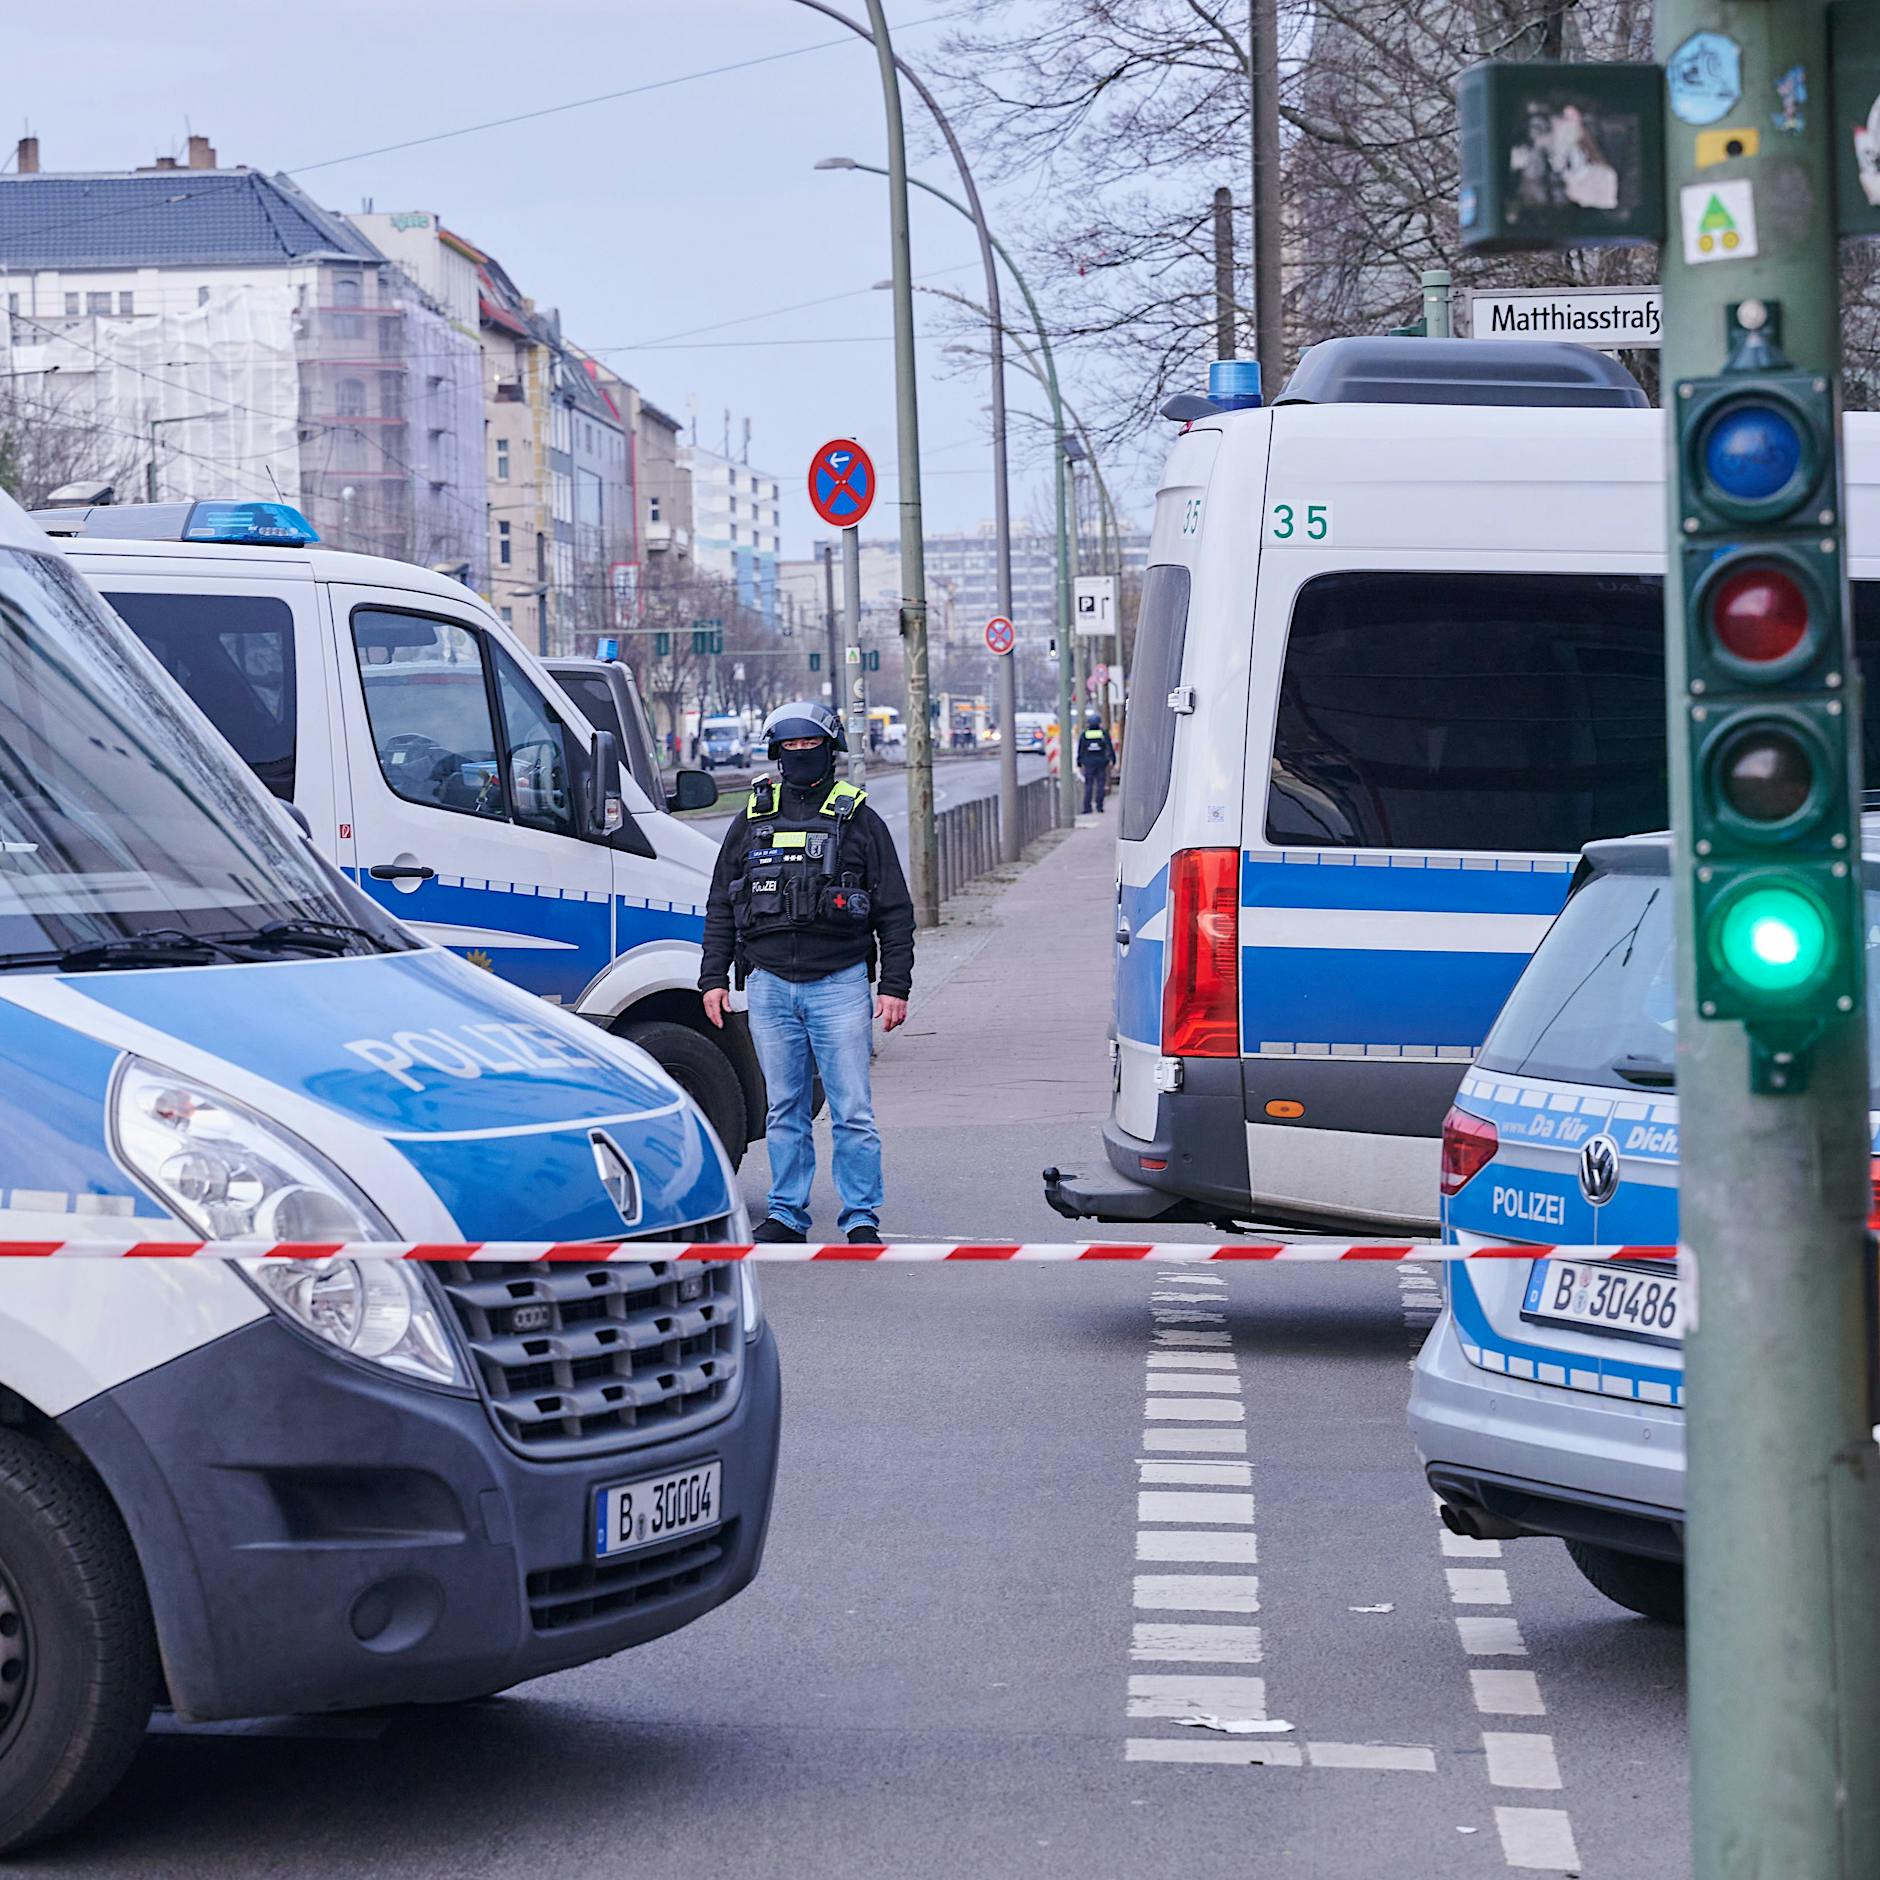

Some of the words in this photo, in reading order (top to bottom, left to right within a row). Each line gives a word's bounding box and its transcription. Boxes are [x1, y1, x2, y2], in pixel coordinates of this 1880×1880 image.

[1491, 300, 1664, 335] Matthiasstraß
[1183, 500, 1201, 534] 35
[1273, 504, 1327, 540] 35
[1555, 1116, 1590, 1142] für
[1493, 1185, 1565, 1226] POLIZEI
[1554, 1268, 1576, 1311] B
[1589, 1274, 1676, 1329] 30486
[620, 1492, 633, 1542] B
[652, 1471, 711, 1533] 30004
